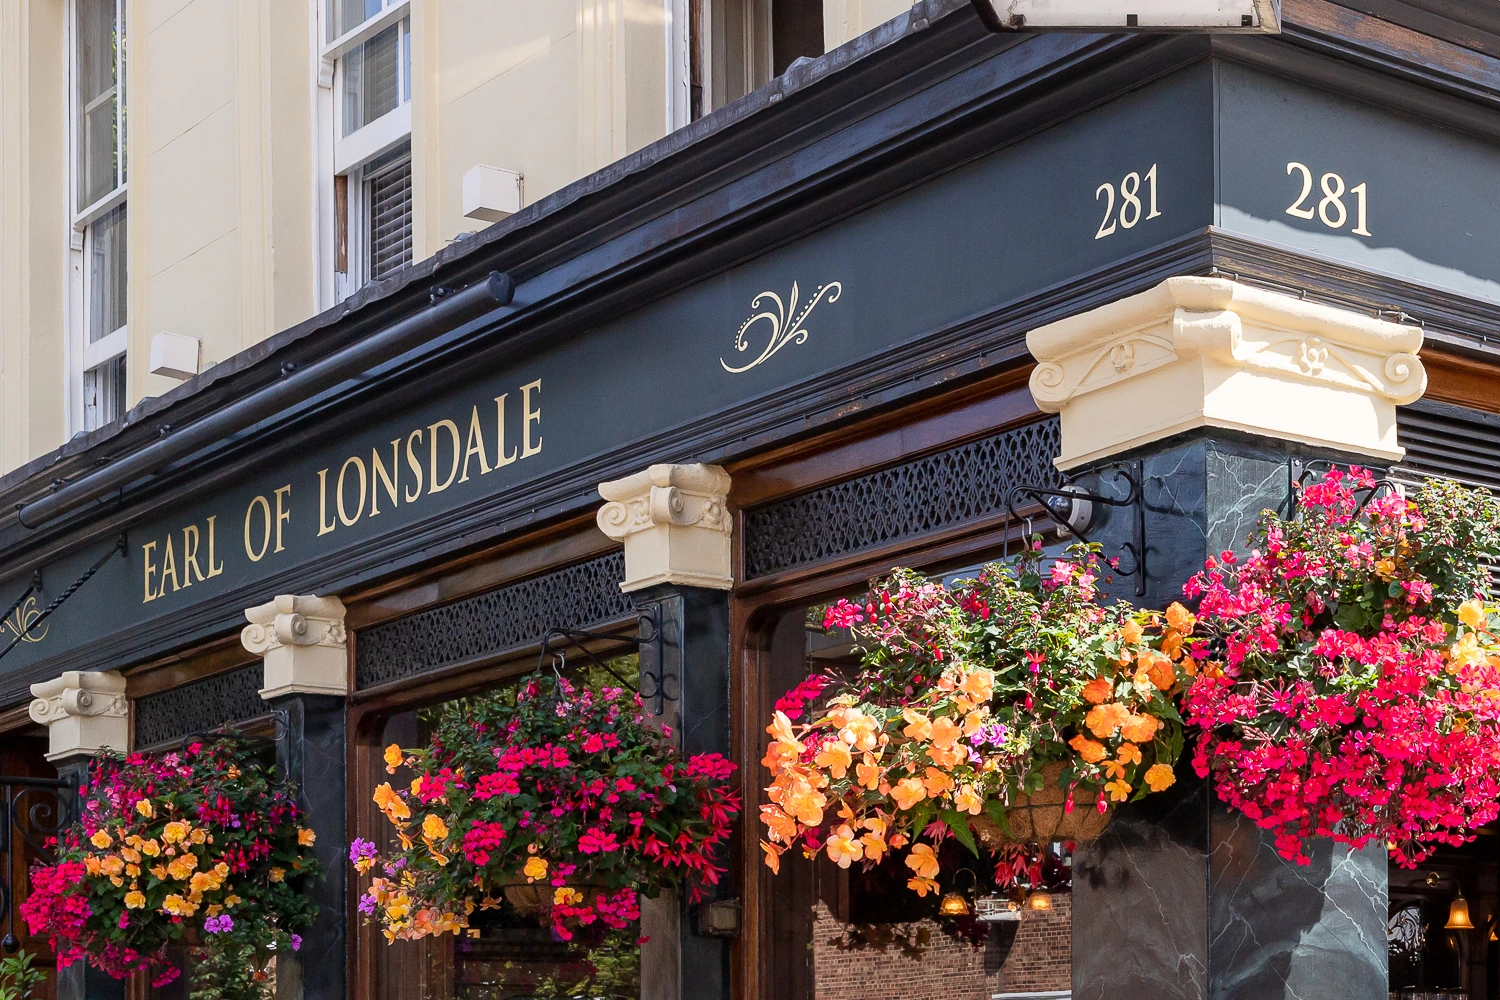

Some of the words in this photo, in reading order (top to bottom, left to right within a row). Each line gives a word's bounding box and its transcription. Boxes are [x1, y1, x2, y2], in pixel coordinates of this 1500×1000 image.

[1094, 162, 1162, 240] 281
[1285, 161, 1372, 238] 281
[141, 514, 225, 604] EARL
[243, 483, 292, 563] OF
[316, 377, 544, 538] LONSDALE
